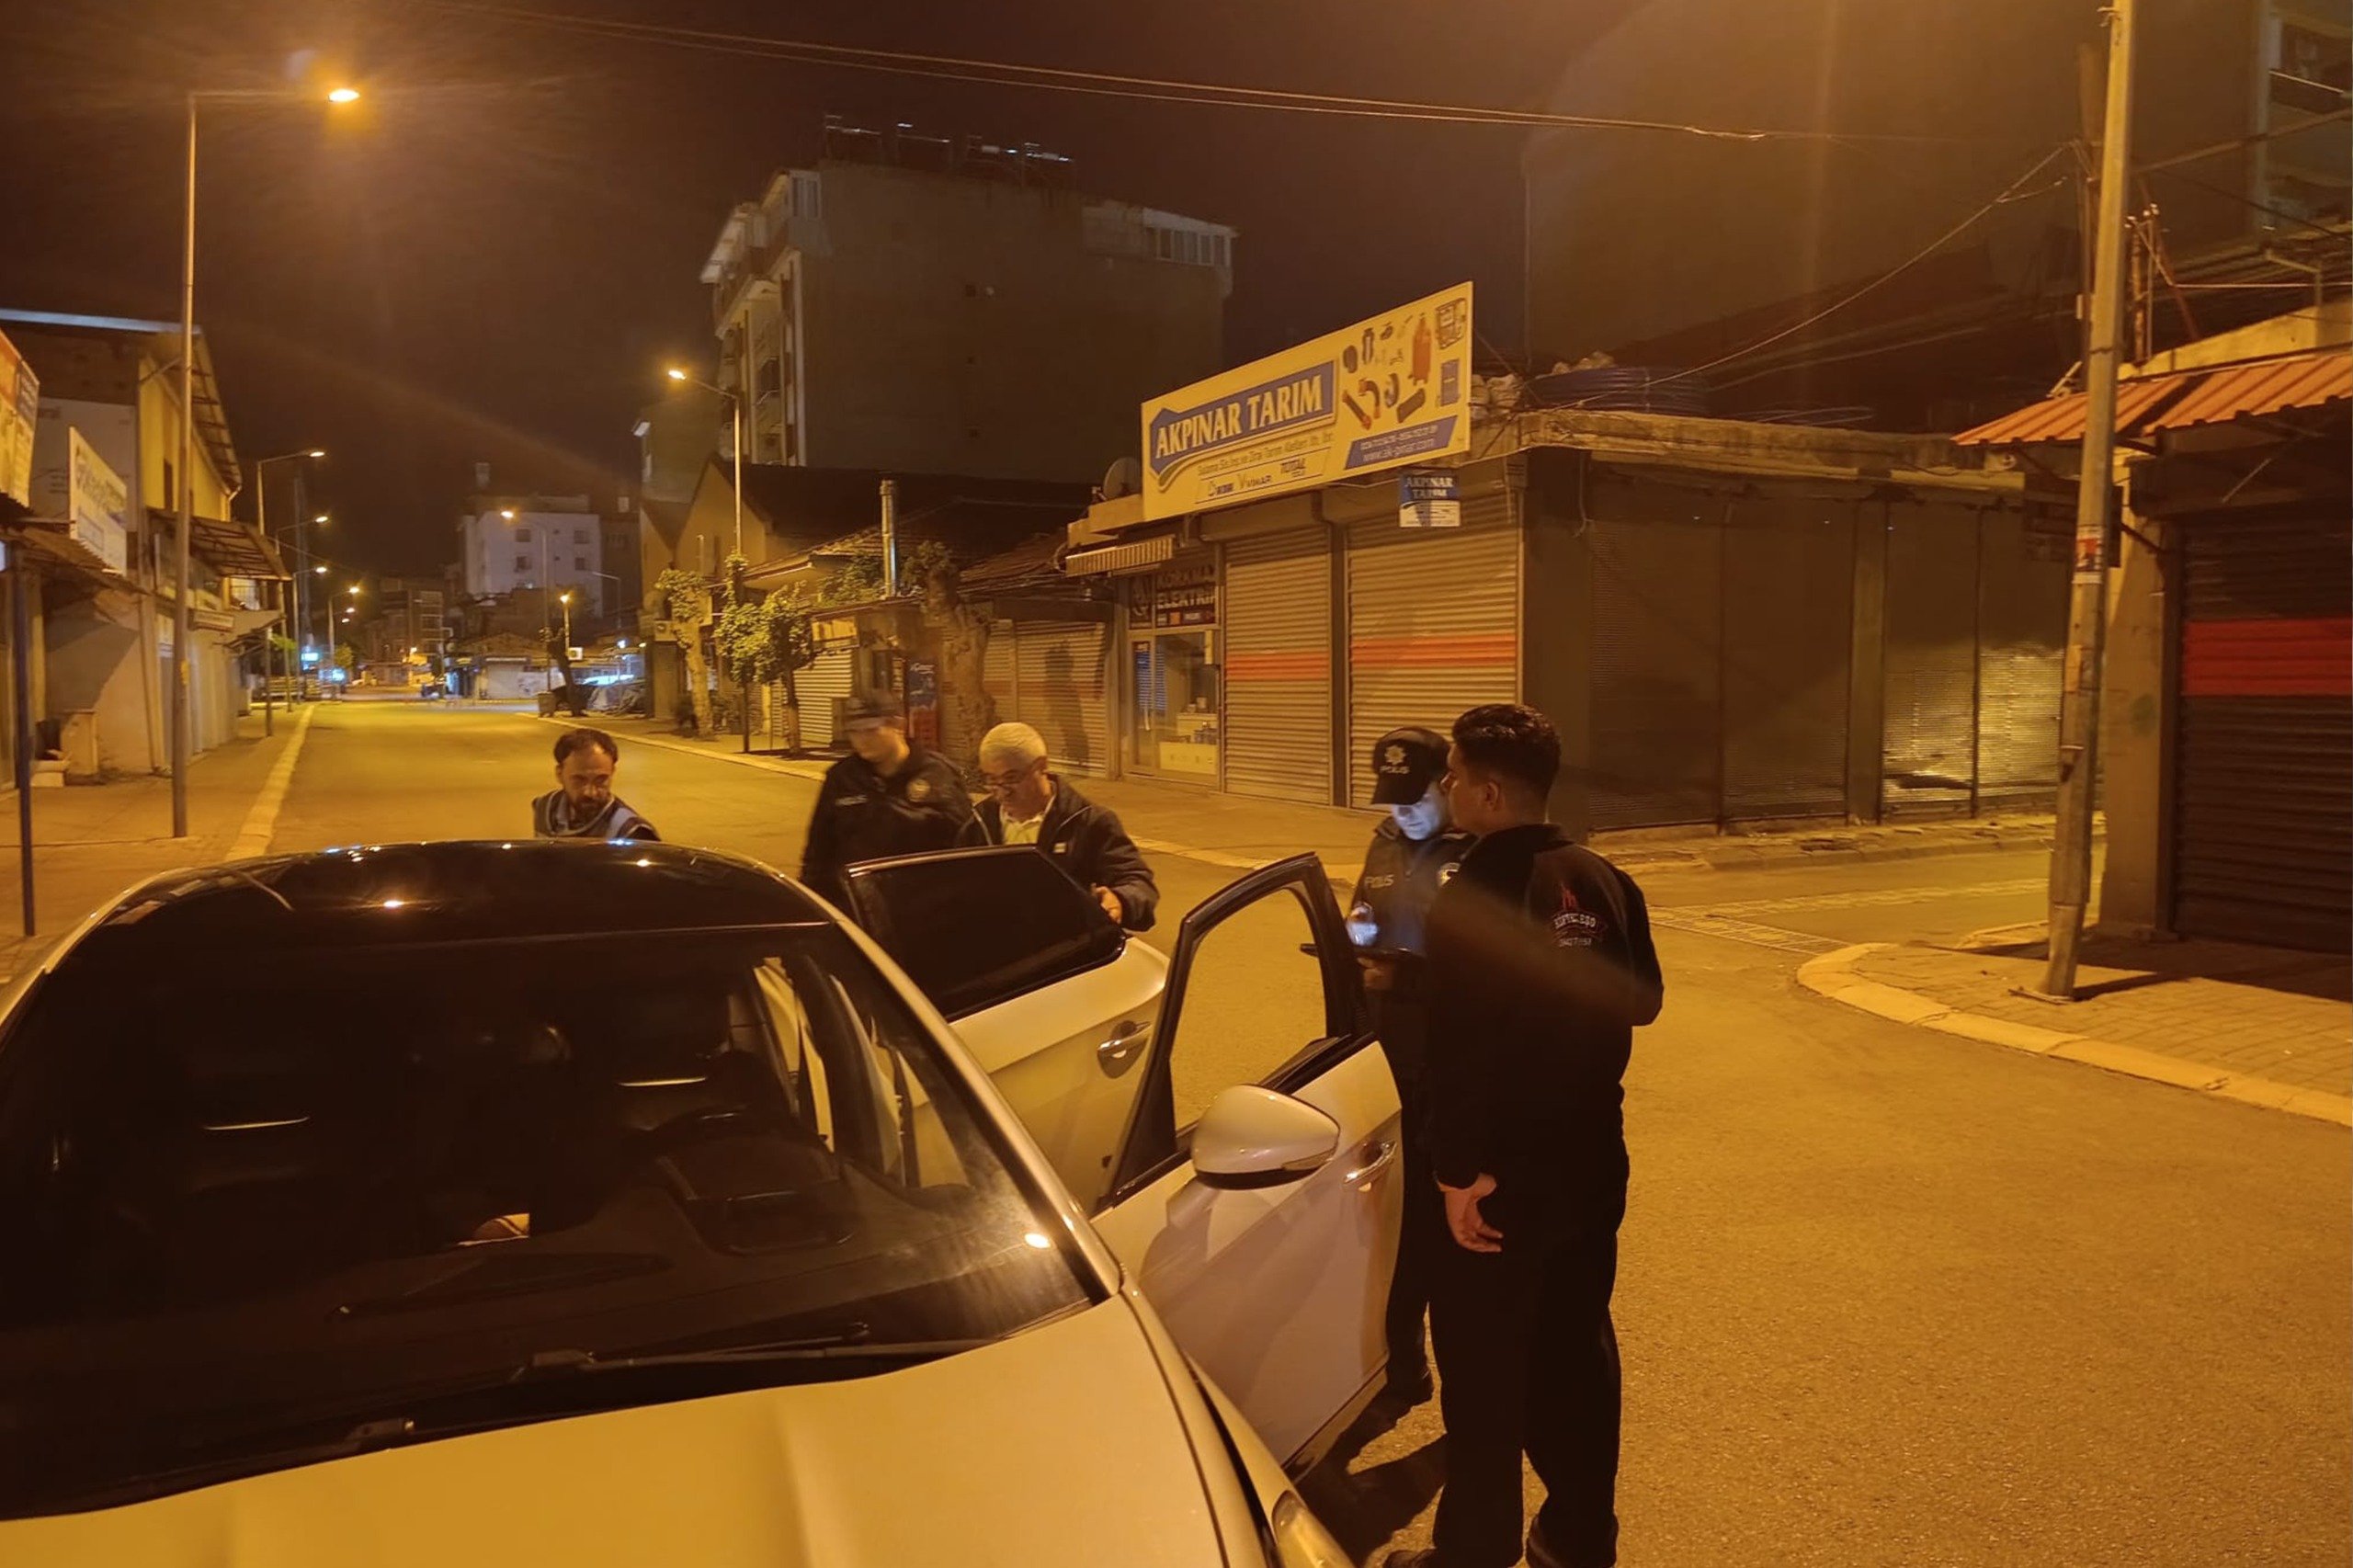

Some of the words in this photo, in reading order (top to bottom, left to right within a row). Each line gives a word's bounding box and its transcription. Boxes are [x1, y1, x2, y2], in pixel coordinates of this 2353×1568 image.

[1155, 402, 1243, 460] AKPINAR
[1246, 374, 1324, 431] TARIM
[1404, 476, 1453, 488] AKPINAR
